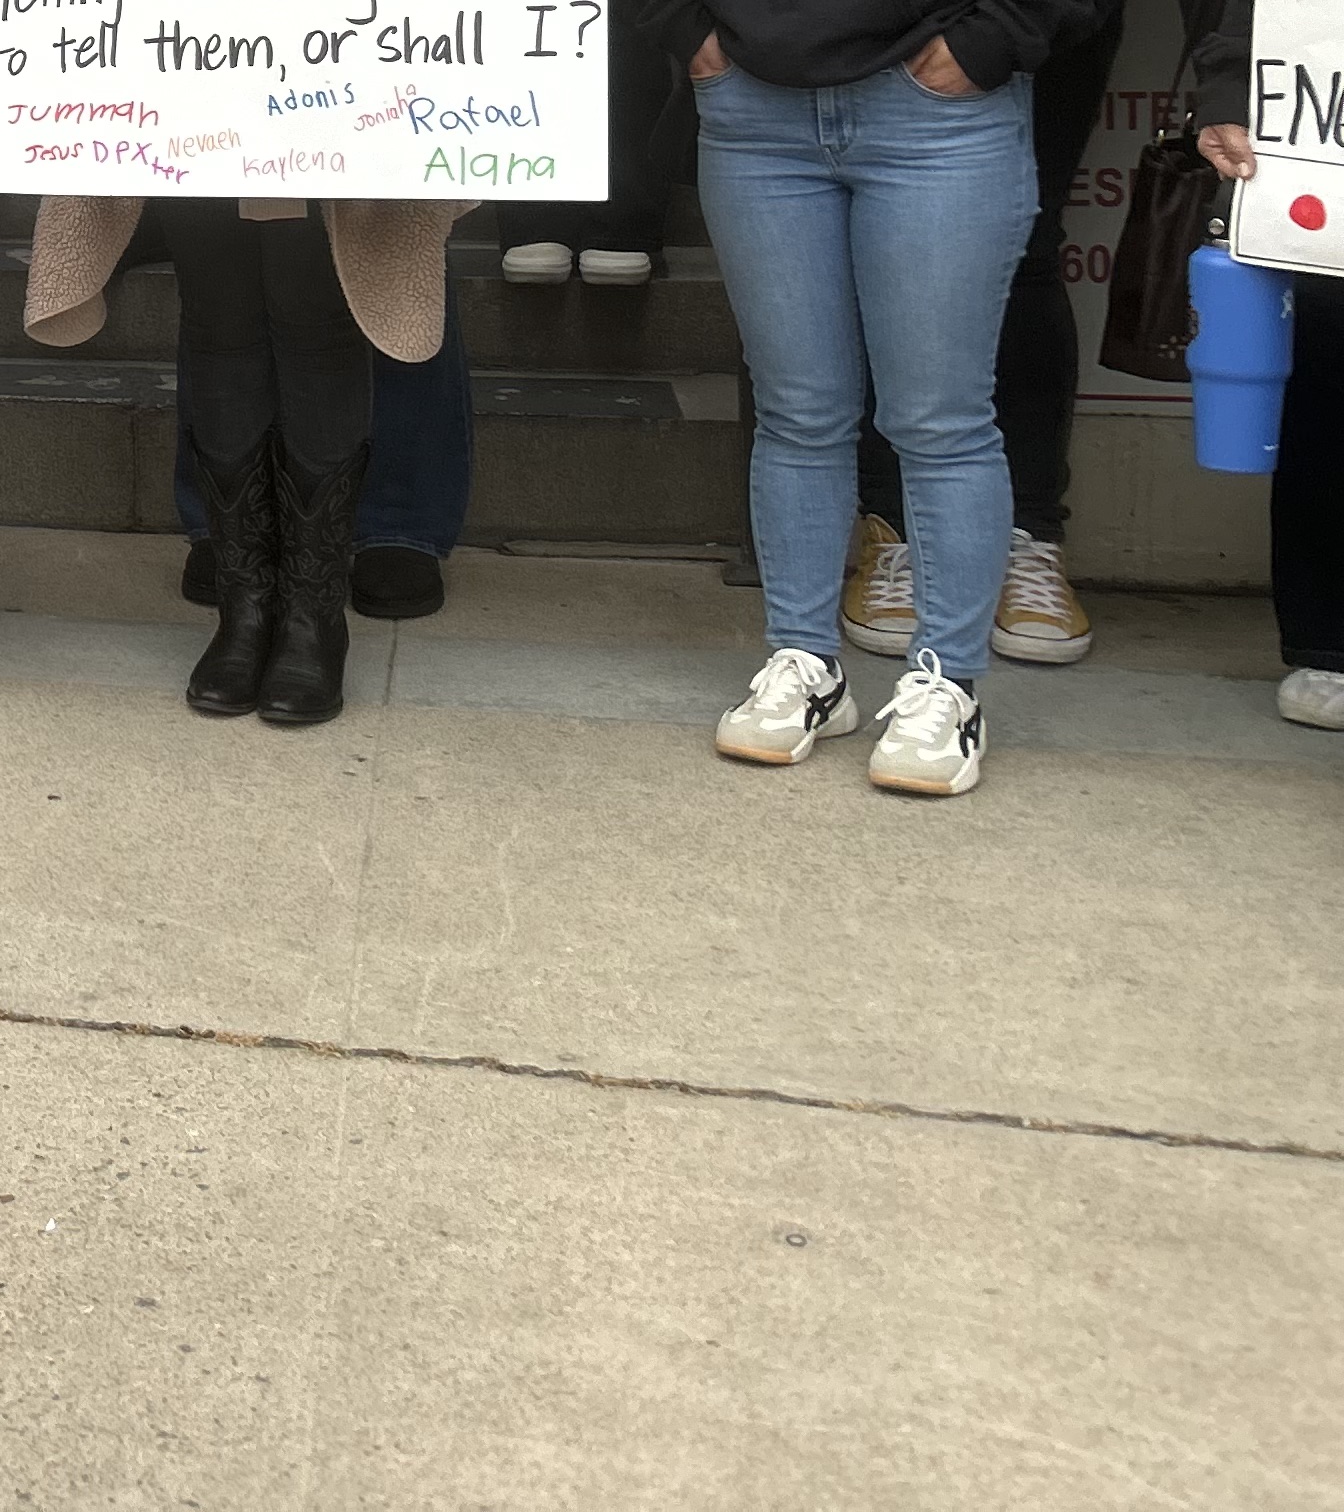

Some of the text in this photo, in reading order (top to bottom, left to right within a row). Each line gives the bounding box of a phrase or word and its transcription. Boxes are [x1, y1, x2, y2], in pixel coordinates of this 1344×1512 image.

[52, 21, 119, 73] tell
[143, 19, 286, 83] them,
[303, 29, 358, 65] or
[267, 79, 356, 116] Adonis
[408, 90, 541, 135] Rafael
[1256, 58, 1344, 149] EN
[423, 146, 555, 186] Alana
